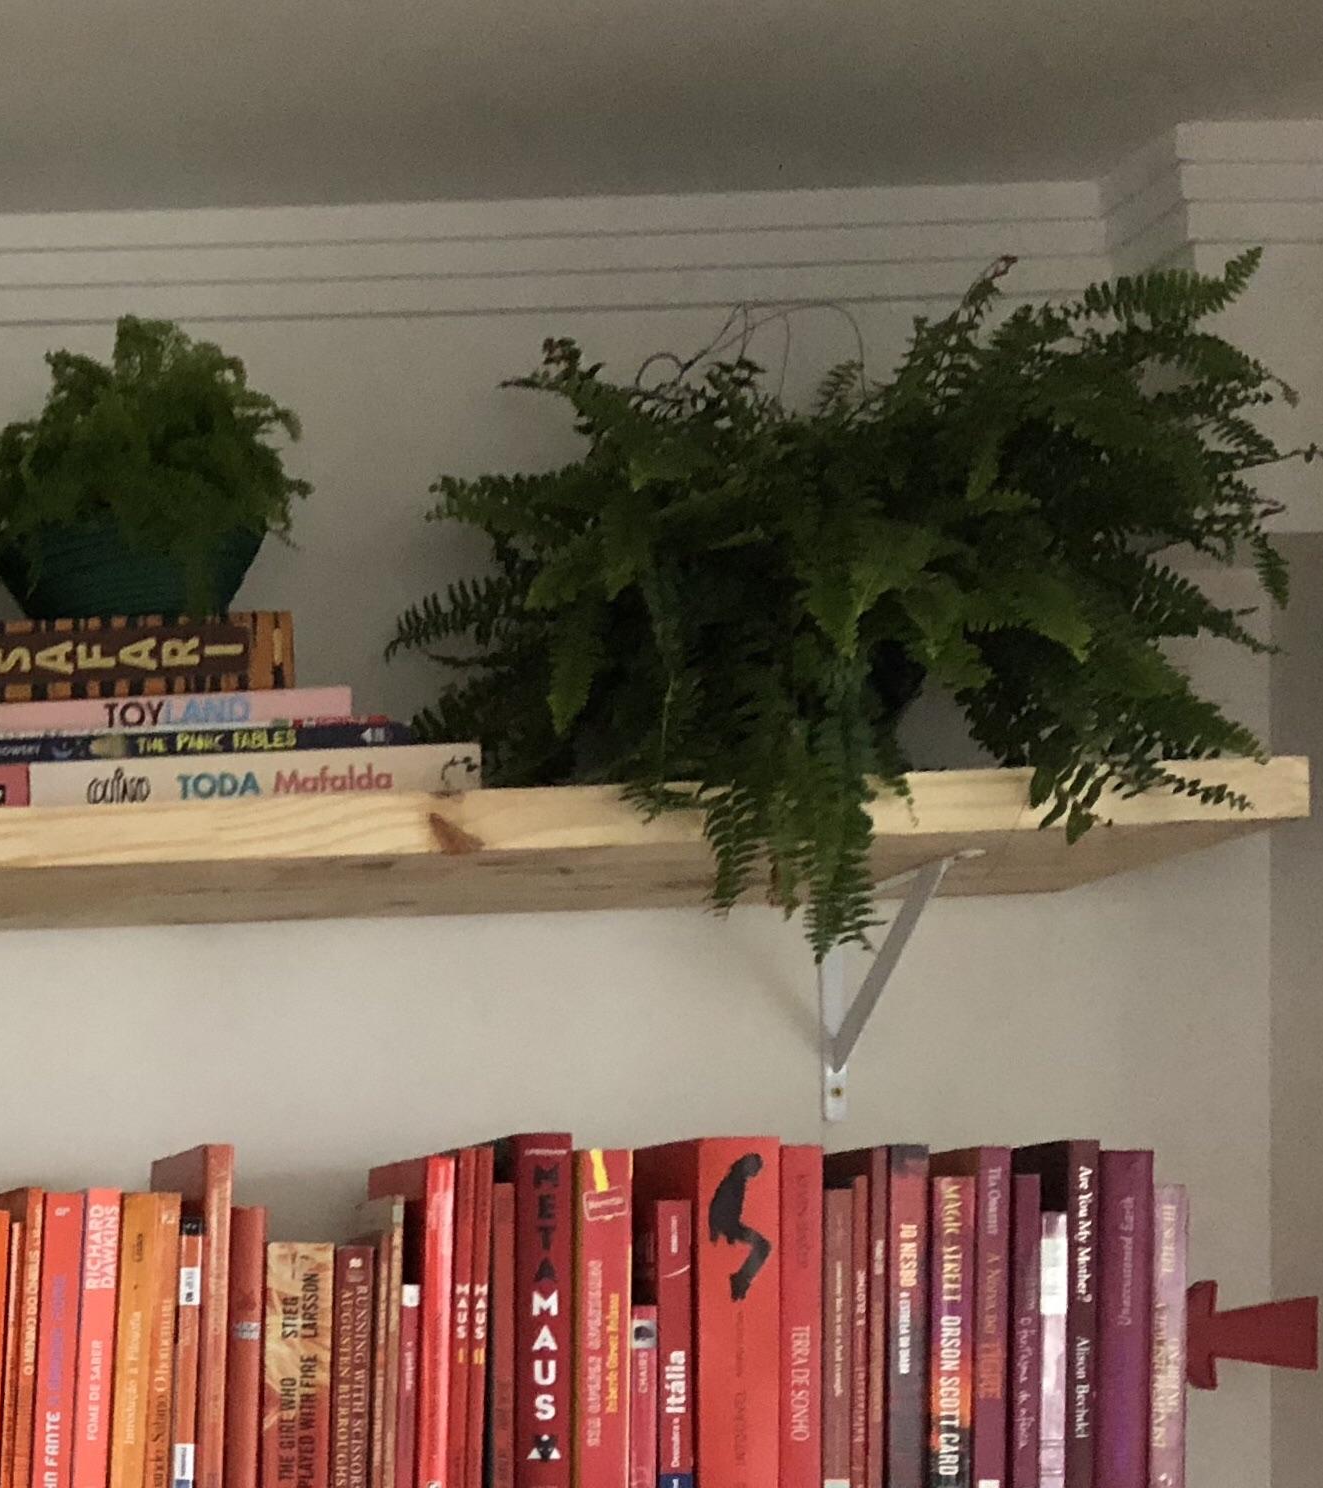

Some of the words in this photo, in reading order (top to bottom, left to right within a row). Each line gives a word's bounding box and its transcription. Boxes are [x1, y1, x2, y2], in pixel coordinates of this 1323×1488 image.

[233, 728, 297, 749] FABLES
[177, 771, 262, 800] TODA
[272, 763, 394, 794] Mafalda
[1078, 1165, 1094, 1189] Are
[1077, 1192, 1093, 1216] You
[85, 1205, 104, 1290] RICHARD
[102, 1205, 119, 1289] DAWKINS
[1074, 1218, 1092, 1243] My
[1075, 1246, 1093, 1303] Mother?
[281, 1296, 299, 1340] STIEG
[302, 1273, 319, 1340] LARSSON
[353, 1285, 368, 1364] RUNNING
[455, 1282, 471, 1340] MAUS
[472, 1282, 489, 1341] MAUS
[338, 1288, 353, 1377] AUGUSTEN
[790, 1326, 811, 1366] TERRA
[939, 1315, 962, 1371] ORSON
[89, 1340, 103, 1381] SABER
[300, 1354, 317, 1390] FIRE
[791, 1368, 810, 1389] DE
[1073, 1335, 1090, 1379] Alison
[87, 1386, 101, 1401] DE
[279, 1378, 298, 1412] WHO
[351, 1369, 366, 1414] WITH
[665, 1350, 687, 1414] Itália
[938, 1376, 961, 1427] SCOTT
[85, 1405, 99, 1441] FOME
[278, 1415, 297, 1450] GIRL
[298, 1394, 316, 1432] WITH
[790, 1390, 811, 1442] SONHO
[43, 1411, 62, 1467] FANTE
[335, 1384, 351, 1487] BURROUGHS
[938, 1432, 960, 1476] CARD
[278, 1453, 296, 1481] THE
